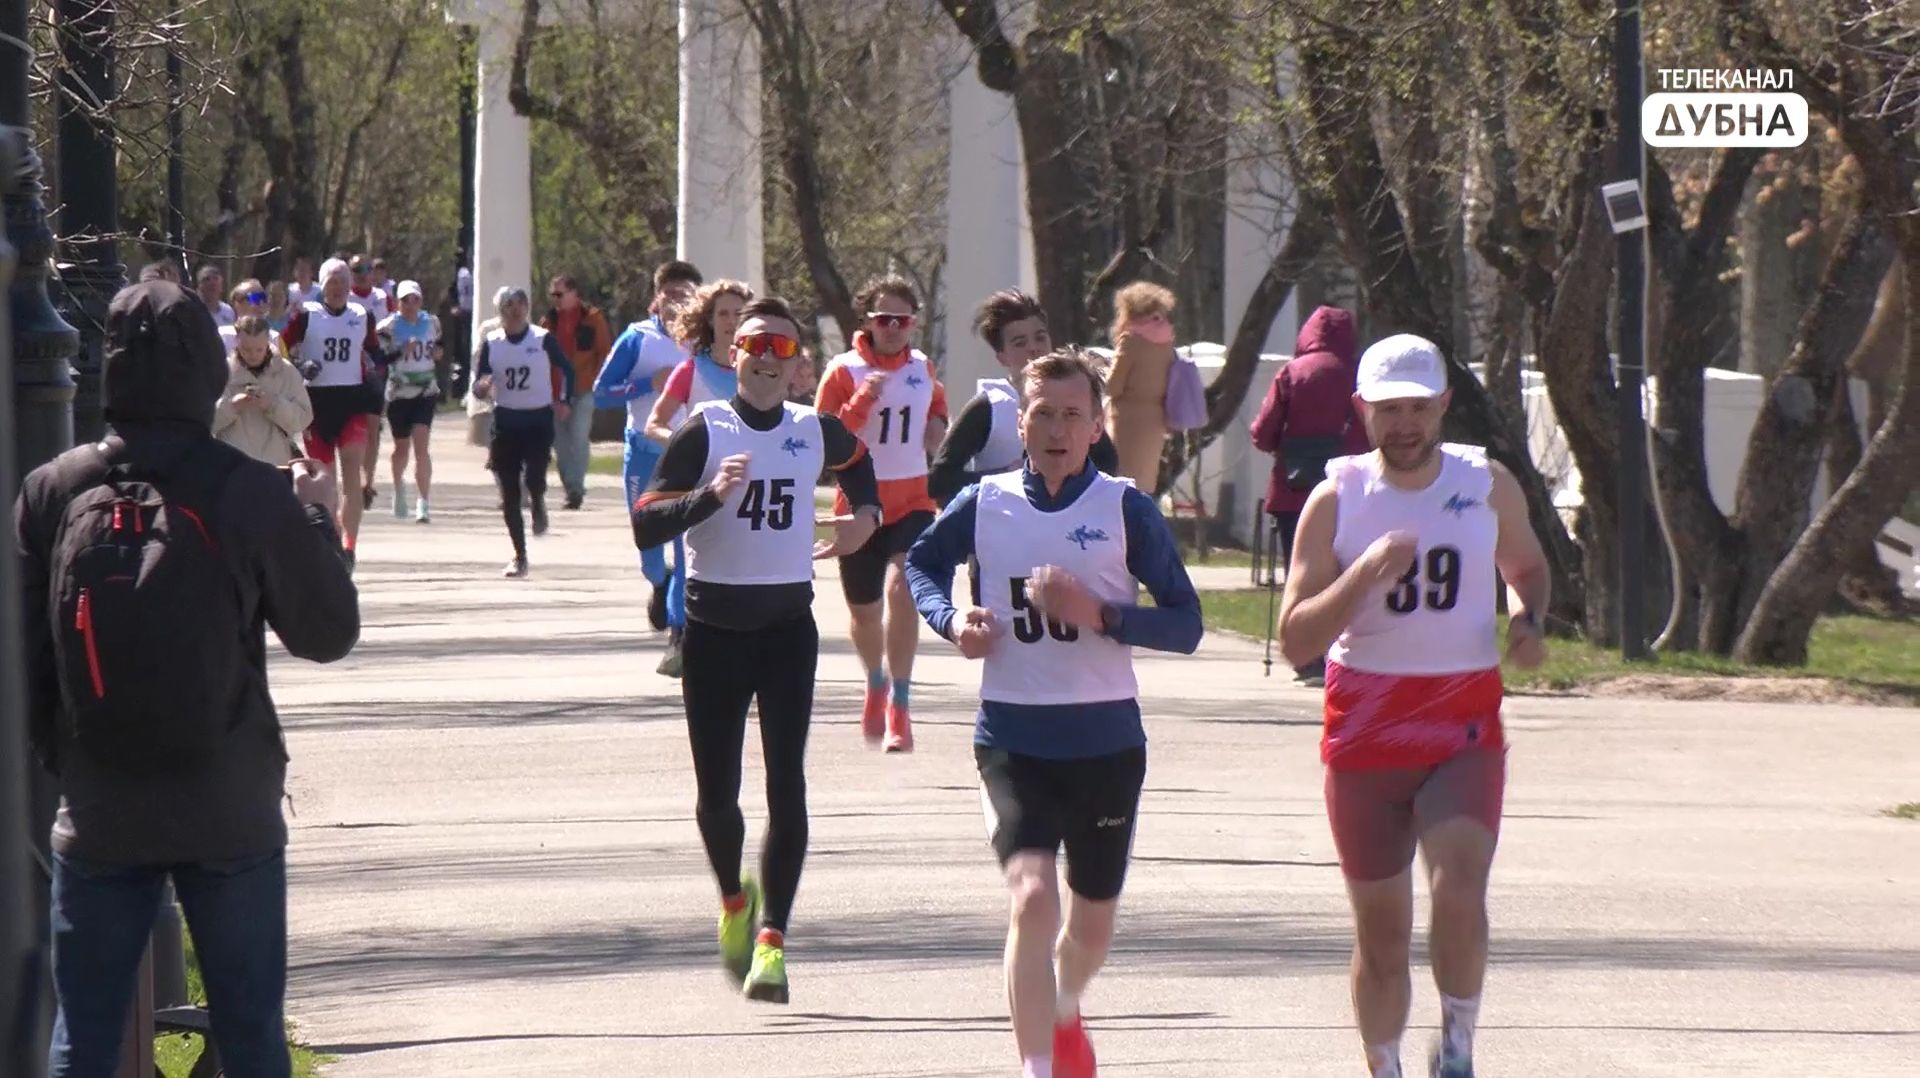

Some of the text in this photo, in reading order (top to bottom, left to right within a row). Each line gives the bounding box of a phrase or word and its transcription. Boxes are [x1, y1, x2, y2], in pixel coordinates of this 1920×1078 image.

[324, 338, 351, 362] 38
[505, 366, 530, 391] 32
[878, 405, 911, 443] 11
[737, 479, 795, 531] 45
